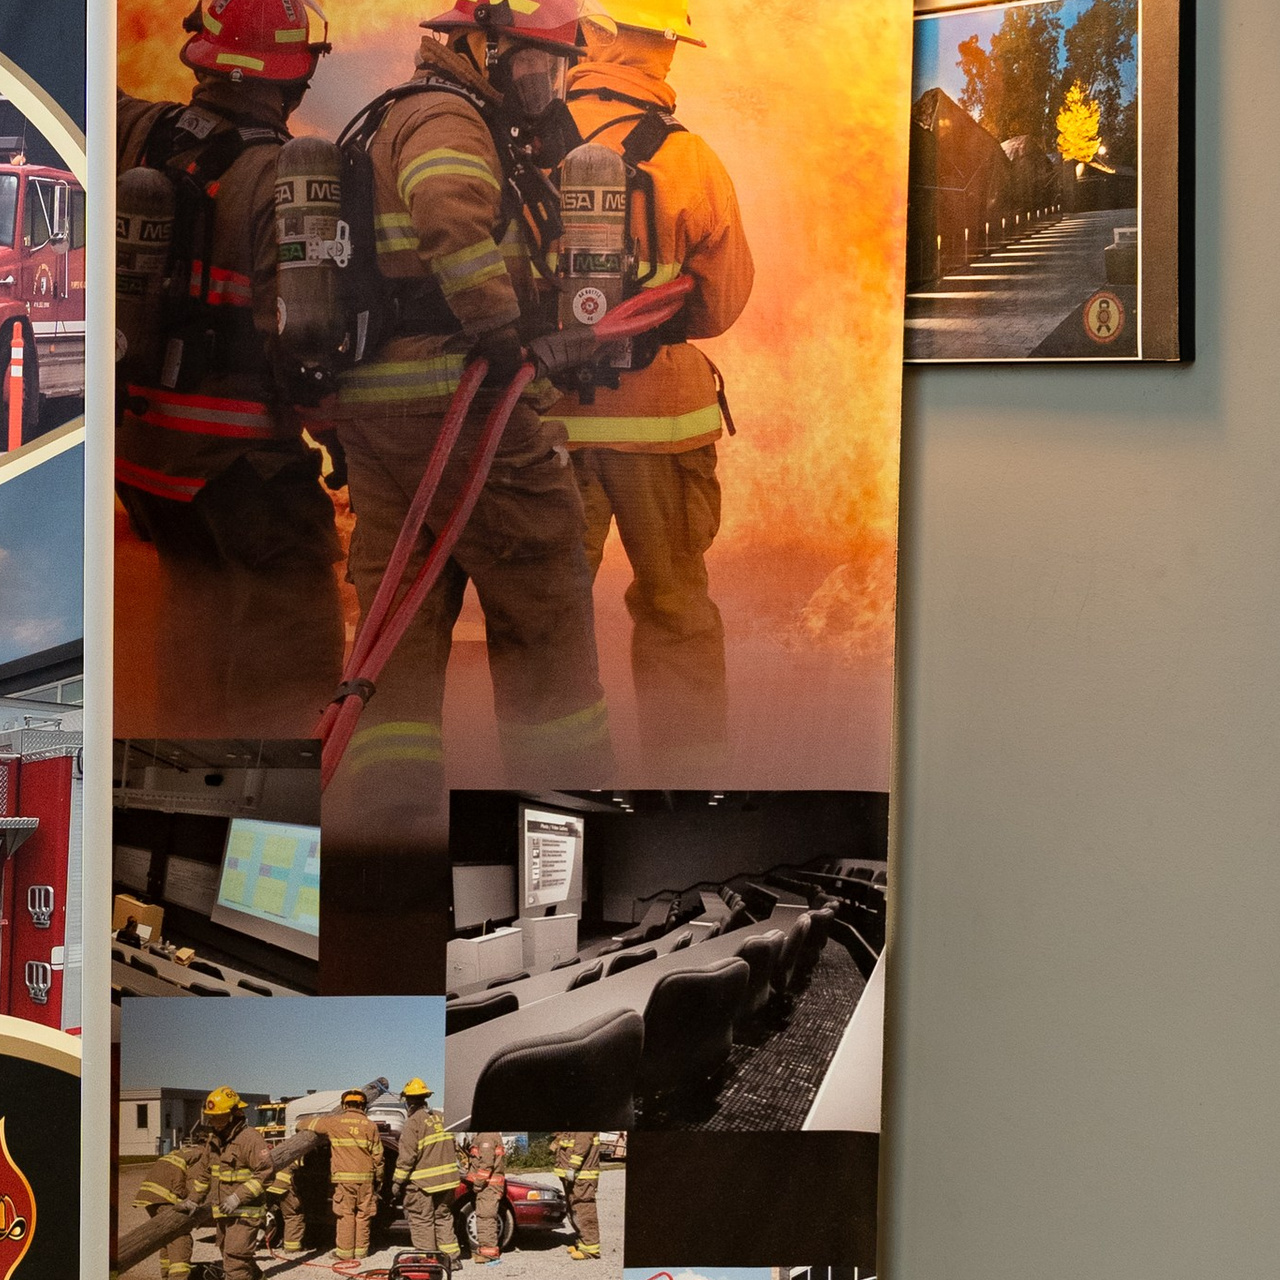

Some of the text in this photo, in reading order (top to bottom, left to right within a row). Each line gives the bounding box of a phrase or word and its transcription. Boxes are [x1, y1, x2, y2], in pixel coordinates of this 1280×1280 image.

[310, 183, 341, 200] MS
[562, 193, 591, 209] SA
[605, 193, 626, 209] MS
[348, 1126, 359, 1135] 76
